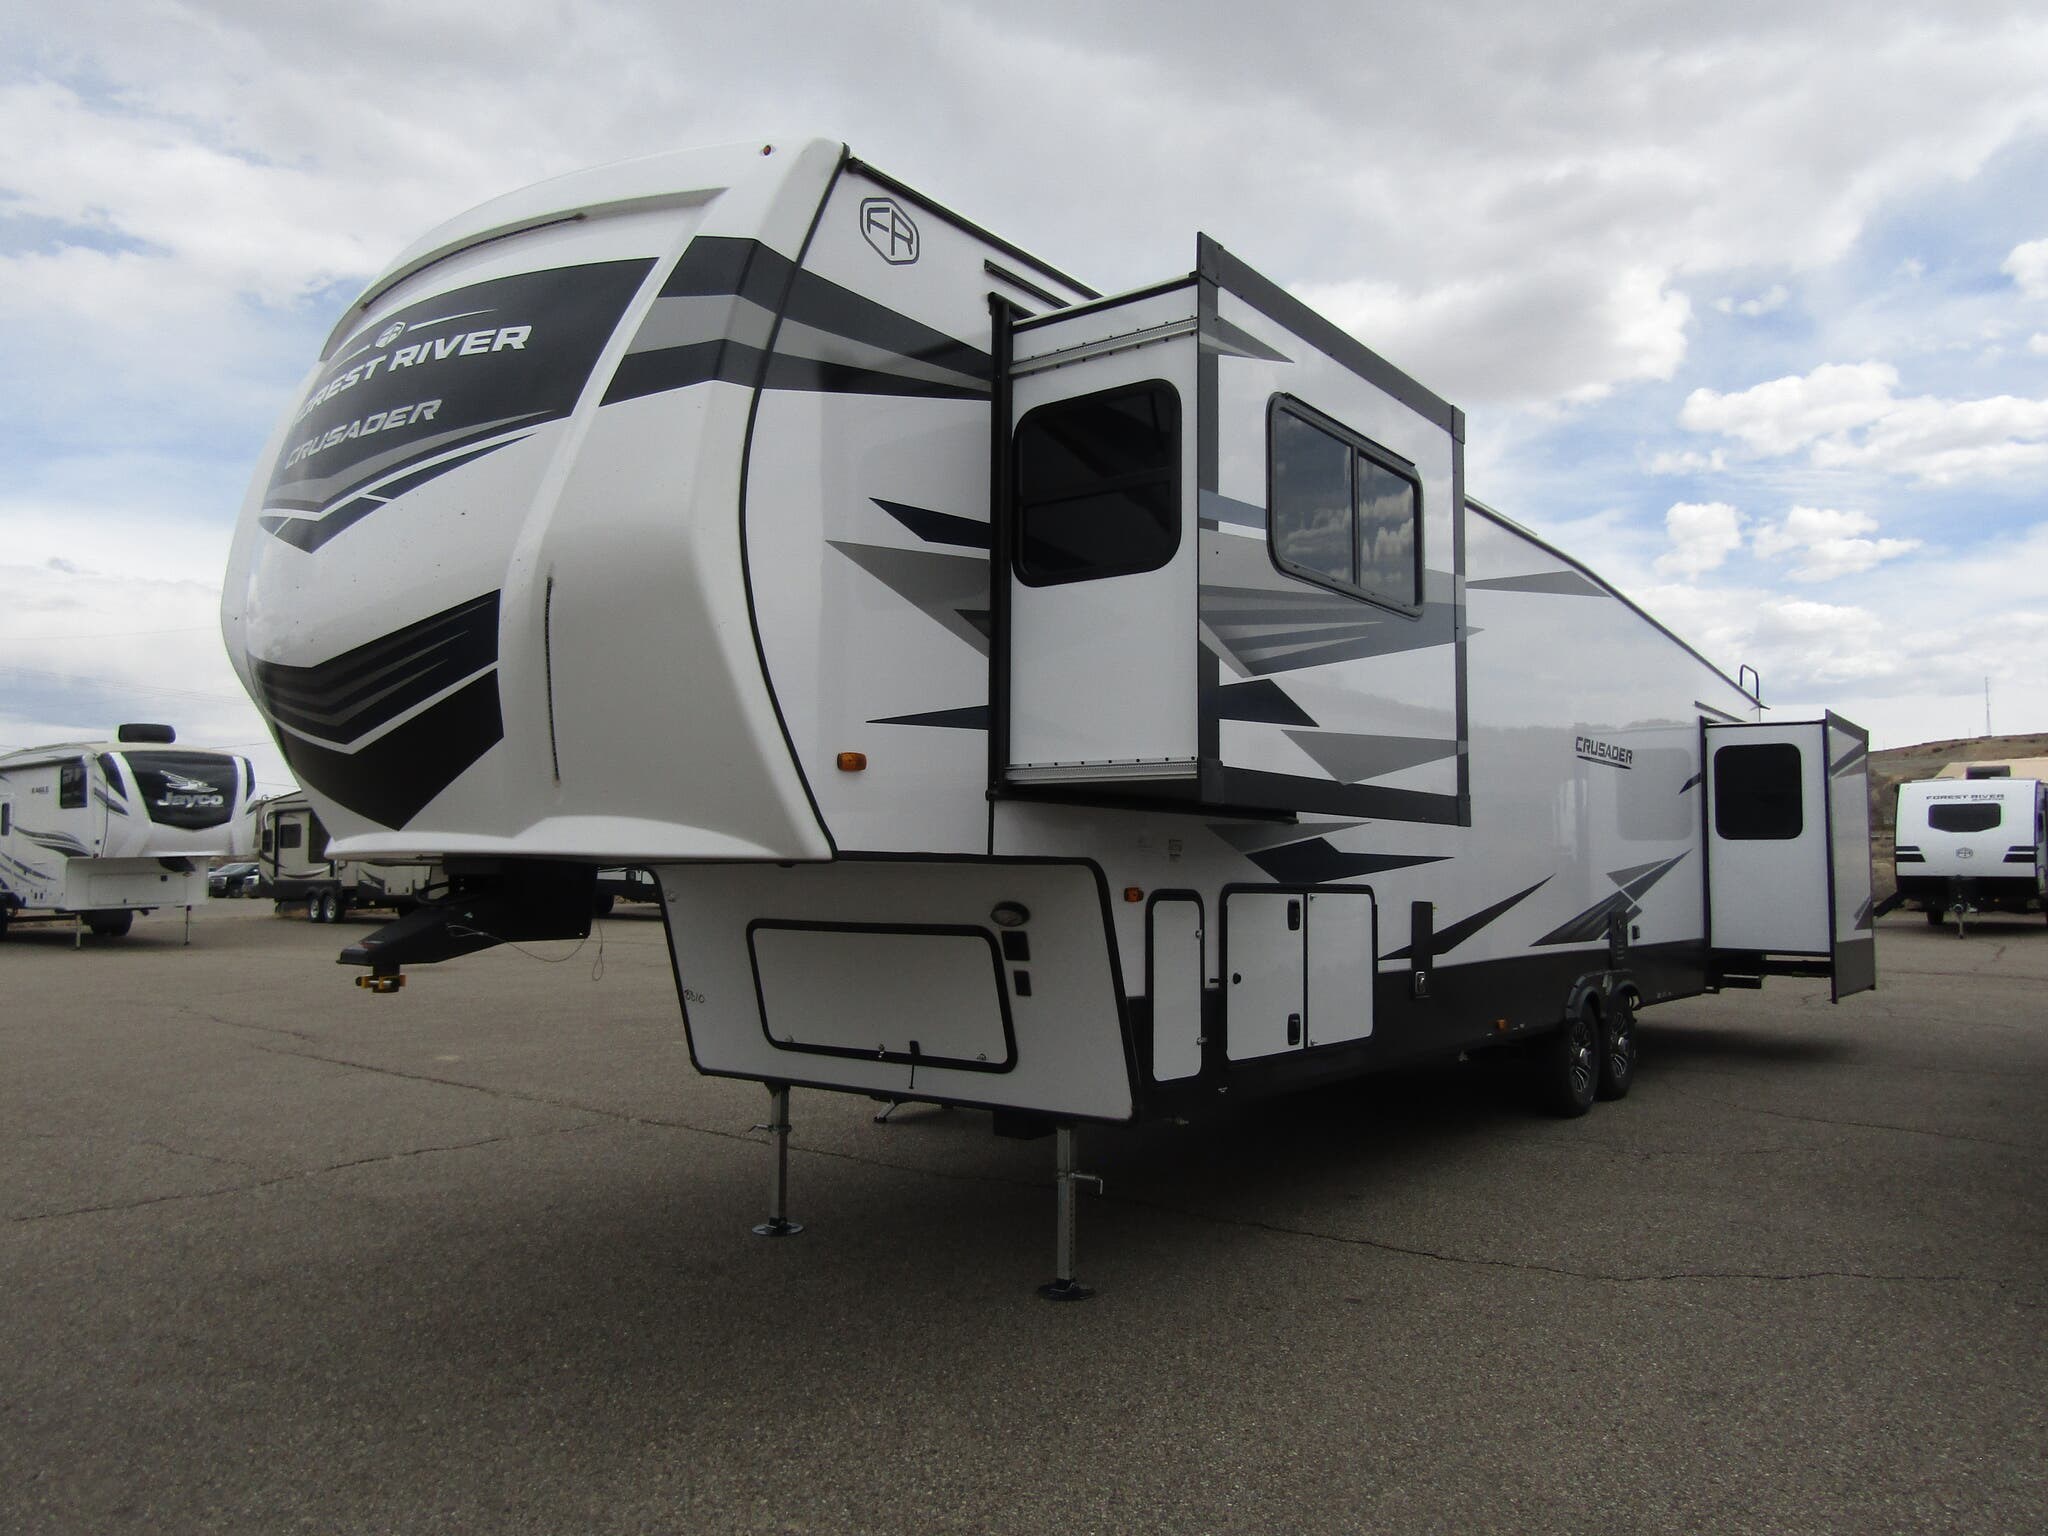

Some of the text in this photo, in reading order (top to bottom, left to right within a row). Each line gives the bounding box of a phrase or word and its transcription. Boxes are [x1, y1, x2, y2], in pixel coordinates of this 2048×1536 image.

[388, 325, 533, 372] RIVER
[285, 399, 442, 470] CRUSADER
[1576, 736, 1633, 764] CRUSADER
[157, 792, 224, 808] Jayco
